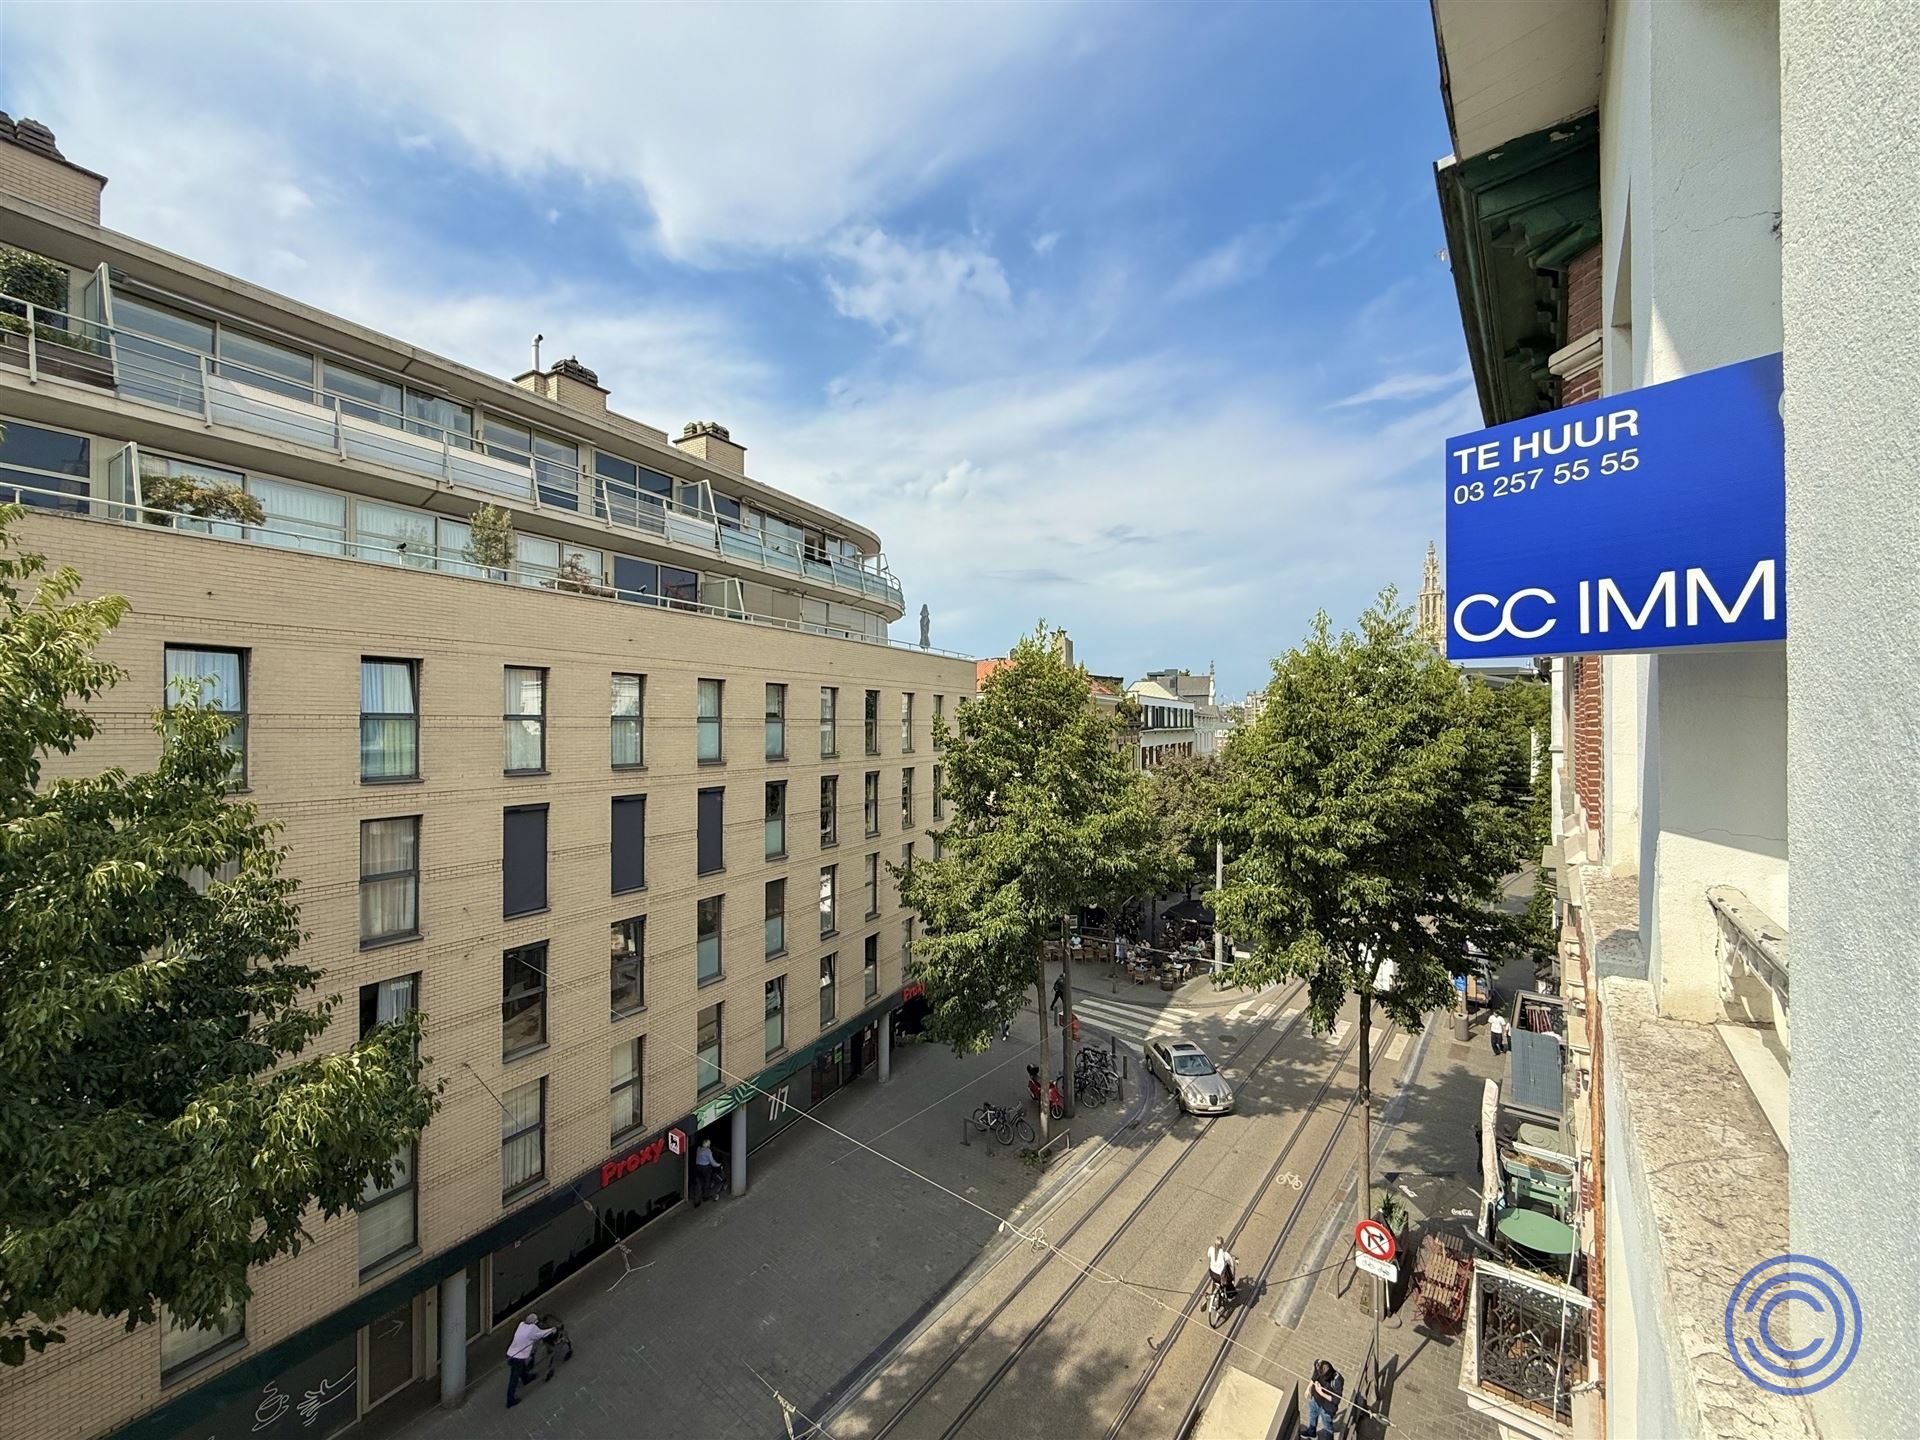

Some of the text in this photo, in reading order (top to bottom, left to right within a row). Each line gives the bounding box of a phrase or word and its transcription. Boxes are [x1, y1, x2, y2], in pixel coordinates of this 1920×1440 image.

[1453, 409, 1639, 474] TE HUUR
[1453, 448, 1640, 505] 03 257 55 55
[1453, 559, 1776, 643] CC IMM
[601, 1135, 665, 1188] Proxy
